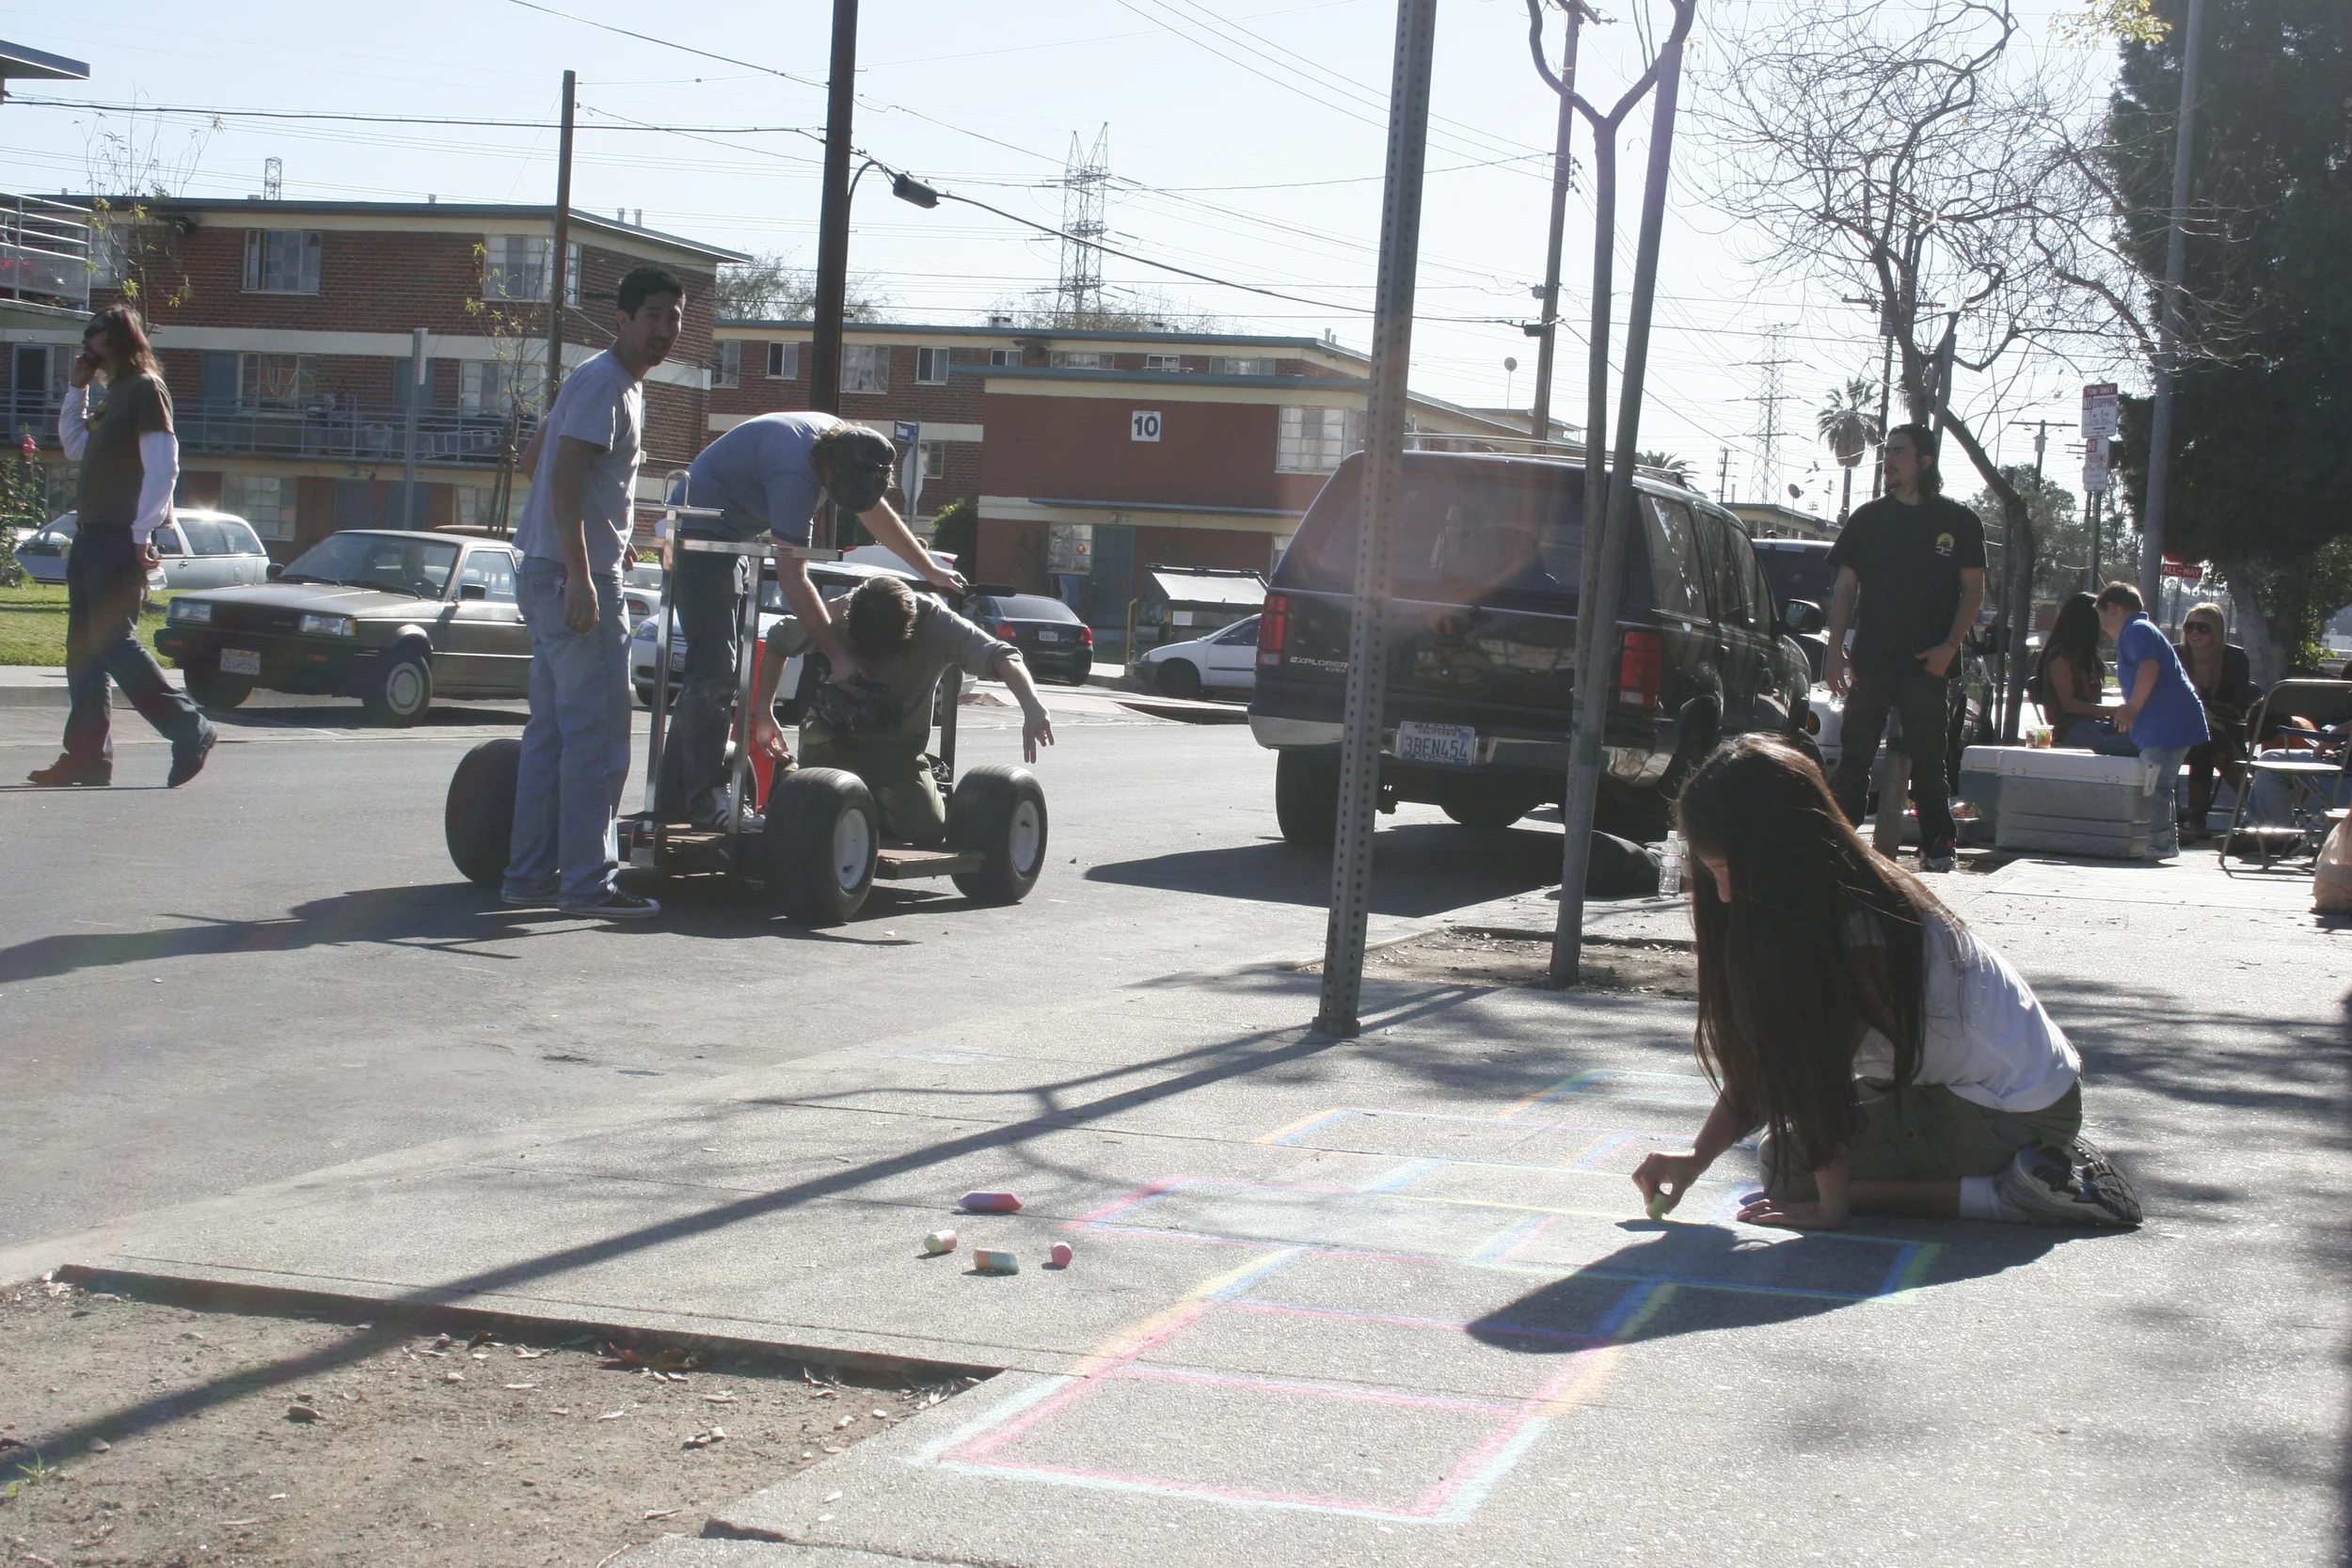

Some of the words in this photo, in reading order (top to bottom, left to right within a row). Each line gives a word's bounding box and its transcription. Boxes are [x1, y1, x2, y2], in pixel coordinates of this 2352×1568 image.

[2084, 397, 2092, 409] NO
[2093, 397, 2116, 408] STOPPING
[1134, 416, 1158, 436] 10
[2087, 440, 2096, 451] NO
[2163, 566, 2201, 577] ALL-WAY
[1290, 657, 1349, 668] EXPLORER
[1405, 736, 1468, 758] 3BEN454
